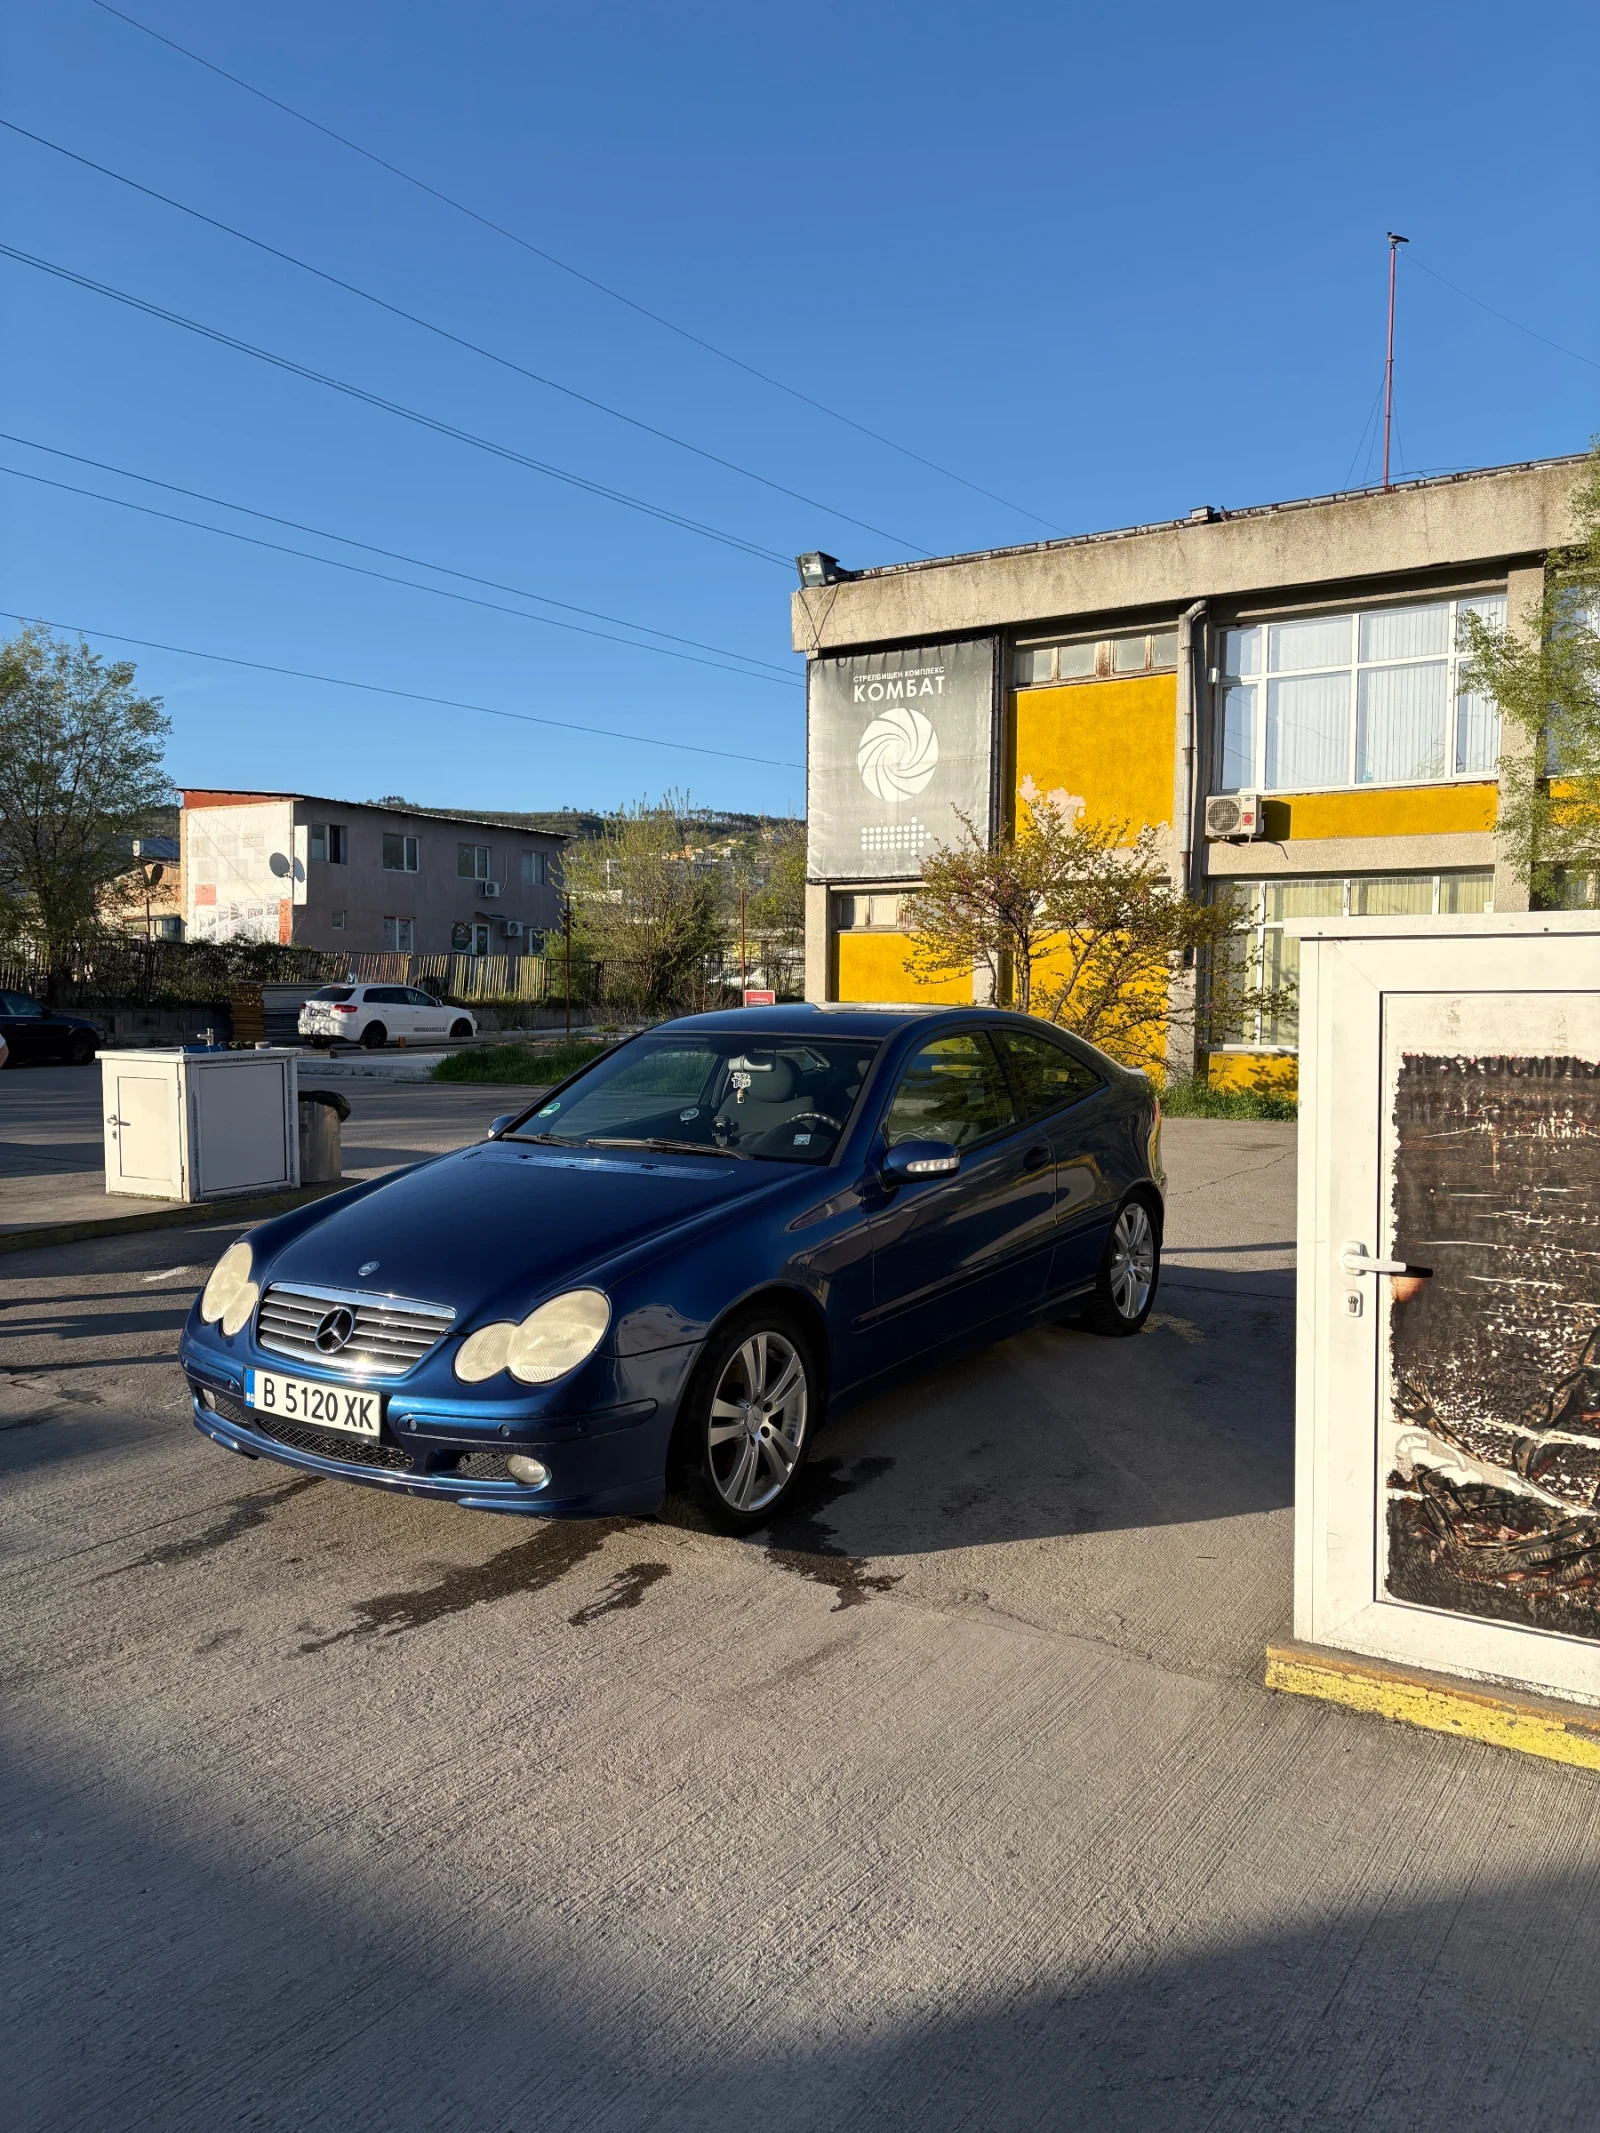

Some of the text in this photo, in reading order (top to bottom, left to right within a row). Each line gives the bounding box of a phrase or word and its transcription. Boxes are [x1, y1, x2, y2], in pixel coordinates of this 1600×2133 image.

[853, 666, 945, 683] СТРЕЛБИЩЕН КОМПЛЕКС
[853, 675, 946, 703] КОМБАТ
[1401, 1053, 1600, 1079] ПРАХОСМУК
[264, 1377, 374, 1431] B 5120 XK
